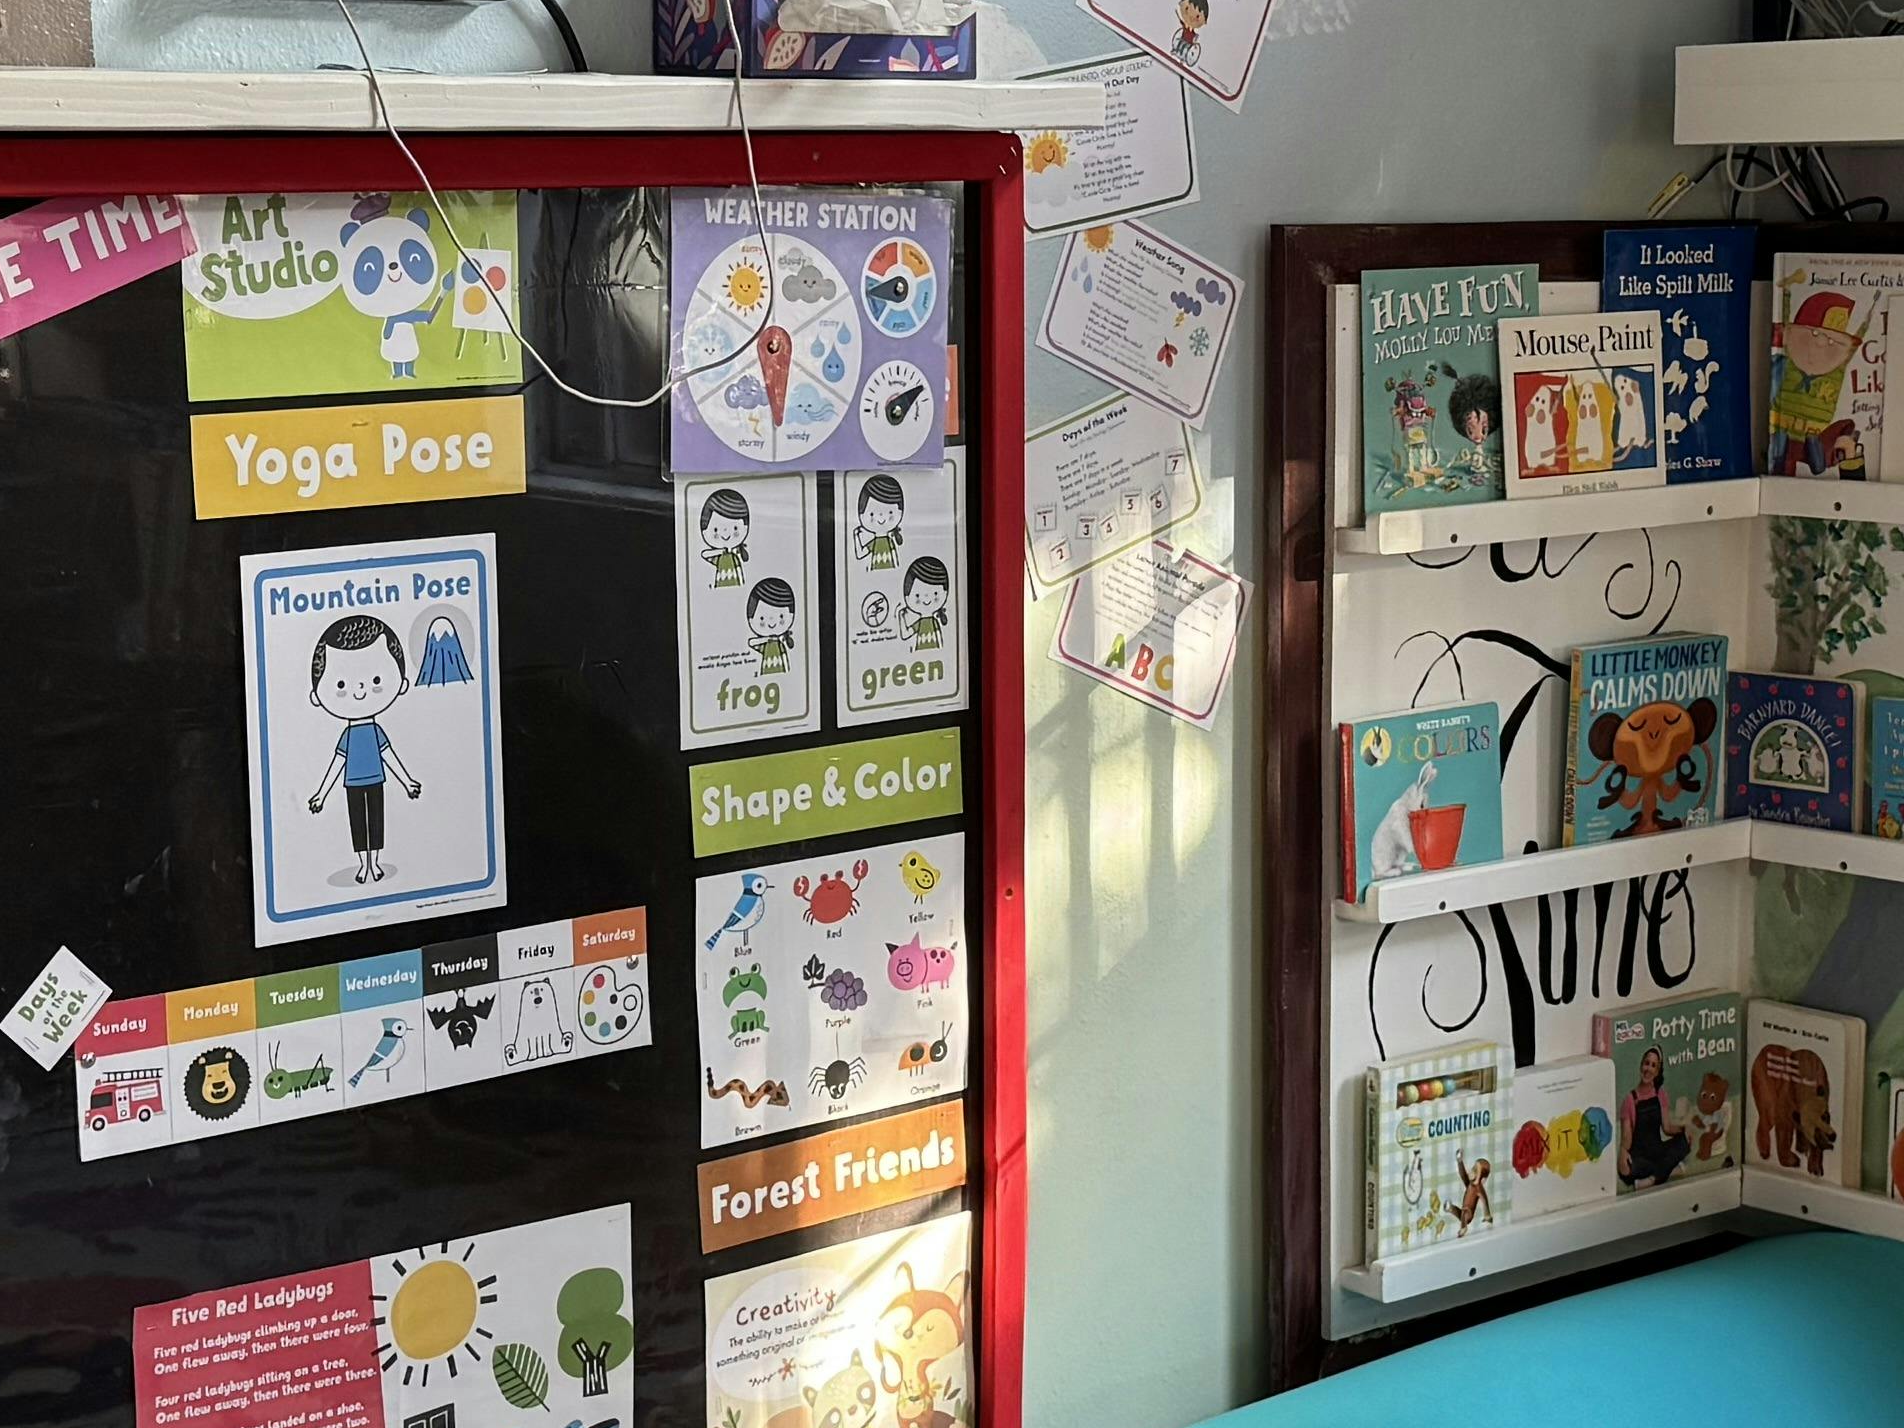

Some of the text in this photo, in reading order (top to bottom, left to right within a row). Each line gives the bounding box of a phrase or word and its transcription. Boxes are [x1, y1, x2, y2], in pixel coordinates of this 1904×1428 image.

[44, 191, 183, 272] TIME
[220, 193, 288, 244] Art
[704, 198, 916, 232] WEATHER STATION
[199, 240, 341, 302] Studio
[1655, 244, 1714, 265] Looked
[1619, 275, 1651, 296] Like
[1697, 273, 1734, 293] Milk
[1369, 278, 1449, 335] HAVE
[1374, 325, 1462, 365] MOLLY LOU
[1514, 324, 1655, 358] Mouse Paint
[225, 421, 494, 498] Yoga Pose
[270, 574, 471, 616] Mountain Pose
[1591, 641, 1722, 677] LITTLE MONKEY
[717, 678, 780, 714] frog
[862, 660, 944, 700] green
[1590, 667, 1721, 712] CALMS DOWN
[1737, 699, 1842, 748] BARNYARD DANCE!
[1398, 725, 1490, 764] COLORS
[701, 760, 953, 827] Shape & Color
[517, 940, 555, 961] Friday
[582, 925, 636, 948] Saturday
[345, 968, 418, 994] Wednesday
[431, 953, 489, 977] Thursday
[18, 972, 58, 1022] Days
[44, 990, 68, 1025] of the
[183, 998, 239, 1022] Monday
[269, 983, 325, 1005] Tuesday
[43, 990, 88, 1043] Week
[94, 1018, 147, 1037] Sunday
[1652, 1007, 1736, 1041] Potty Time
[1668, 1037, 1735, 1066] with Bean
[1428, 1110, 1490, 1138] COUNTING
[1557, 1129, 1570, 1149] IT
[711, 1129, 956, 1226] Forest Friends
[172, 1282, 334, 1327] Five Red Ladybugs
[736, 1287, 836, 1326] Creativity
